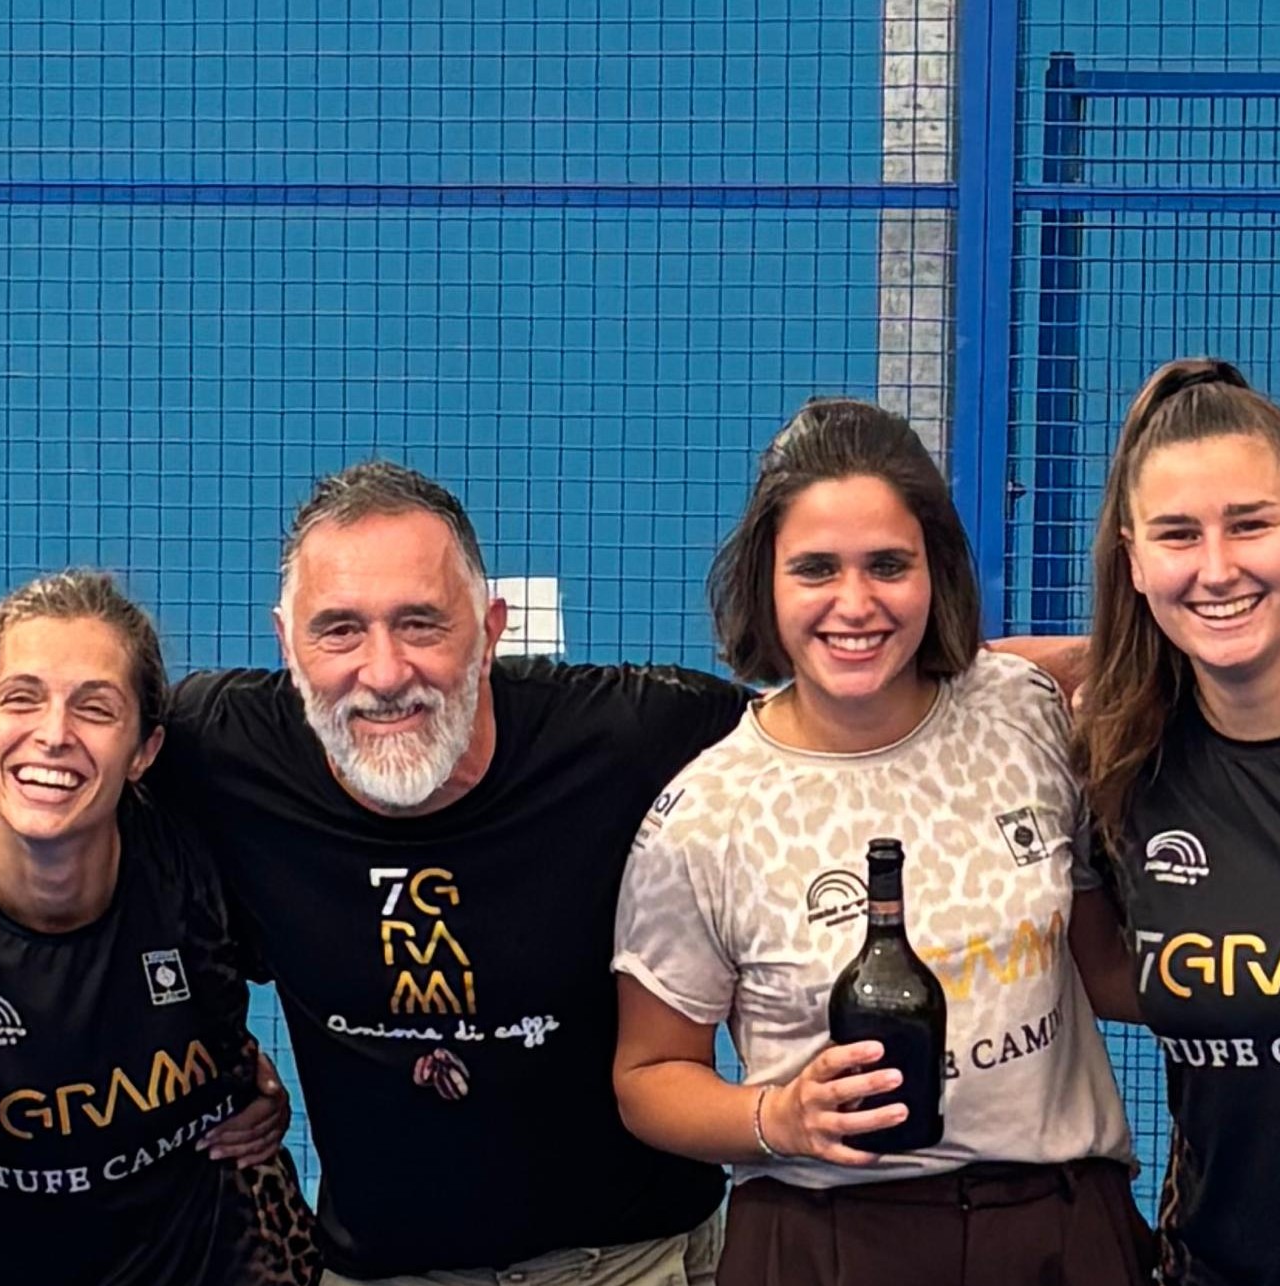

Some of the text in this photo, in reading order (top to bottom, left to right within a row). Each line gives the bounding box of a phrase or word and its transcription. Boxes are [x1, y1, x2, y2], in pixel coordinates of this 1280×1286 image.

[369, 867, 461, 916] 7G
[381, 919, 471, 966] RA
[455, 1019, 485, 1042] di
[1161, 1036, 1259, 1068] TUFE
[102, 1094, 235, 1182] CAMINI
